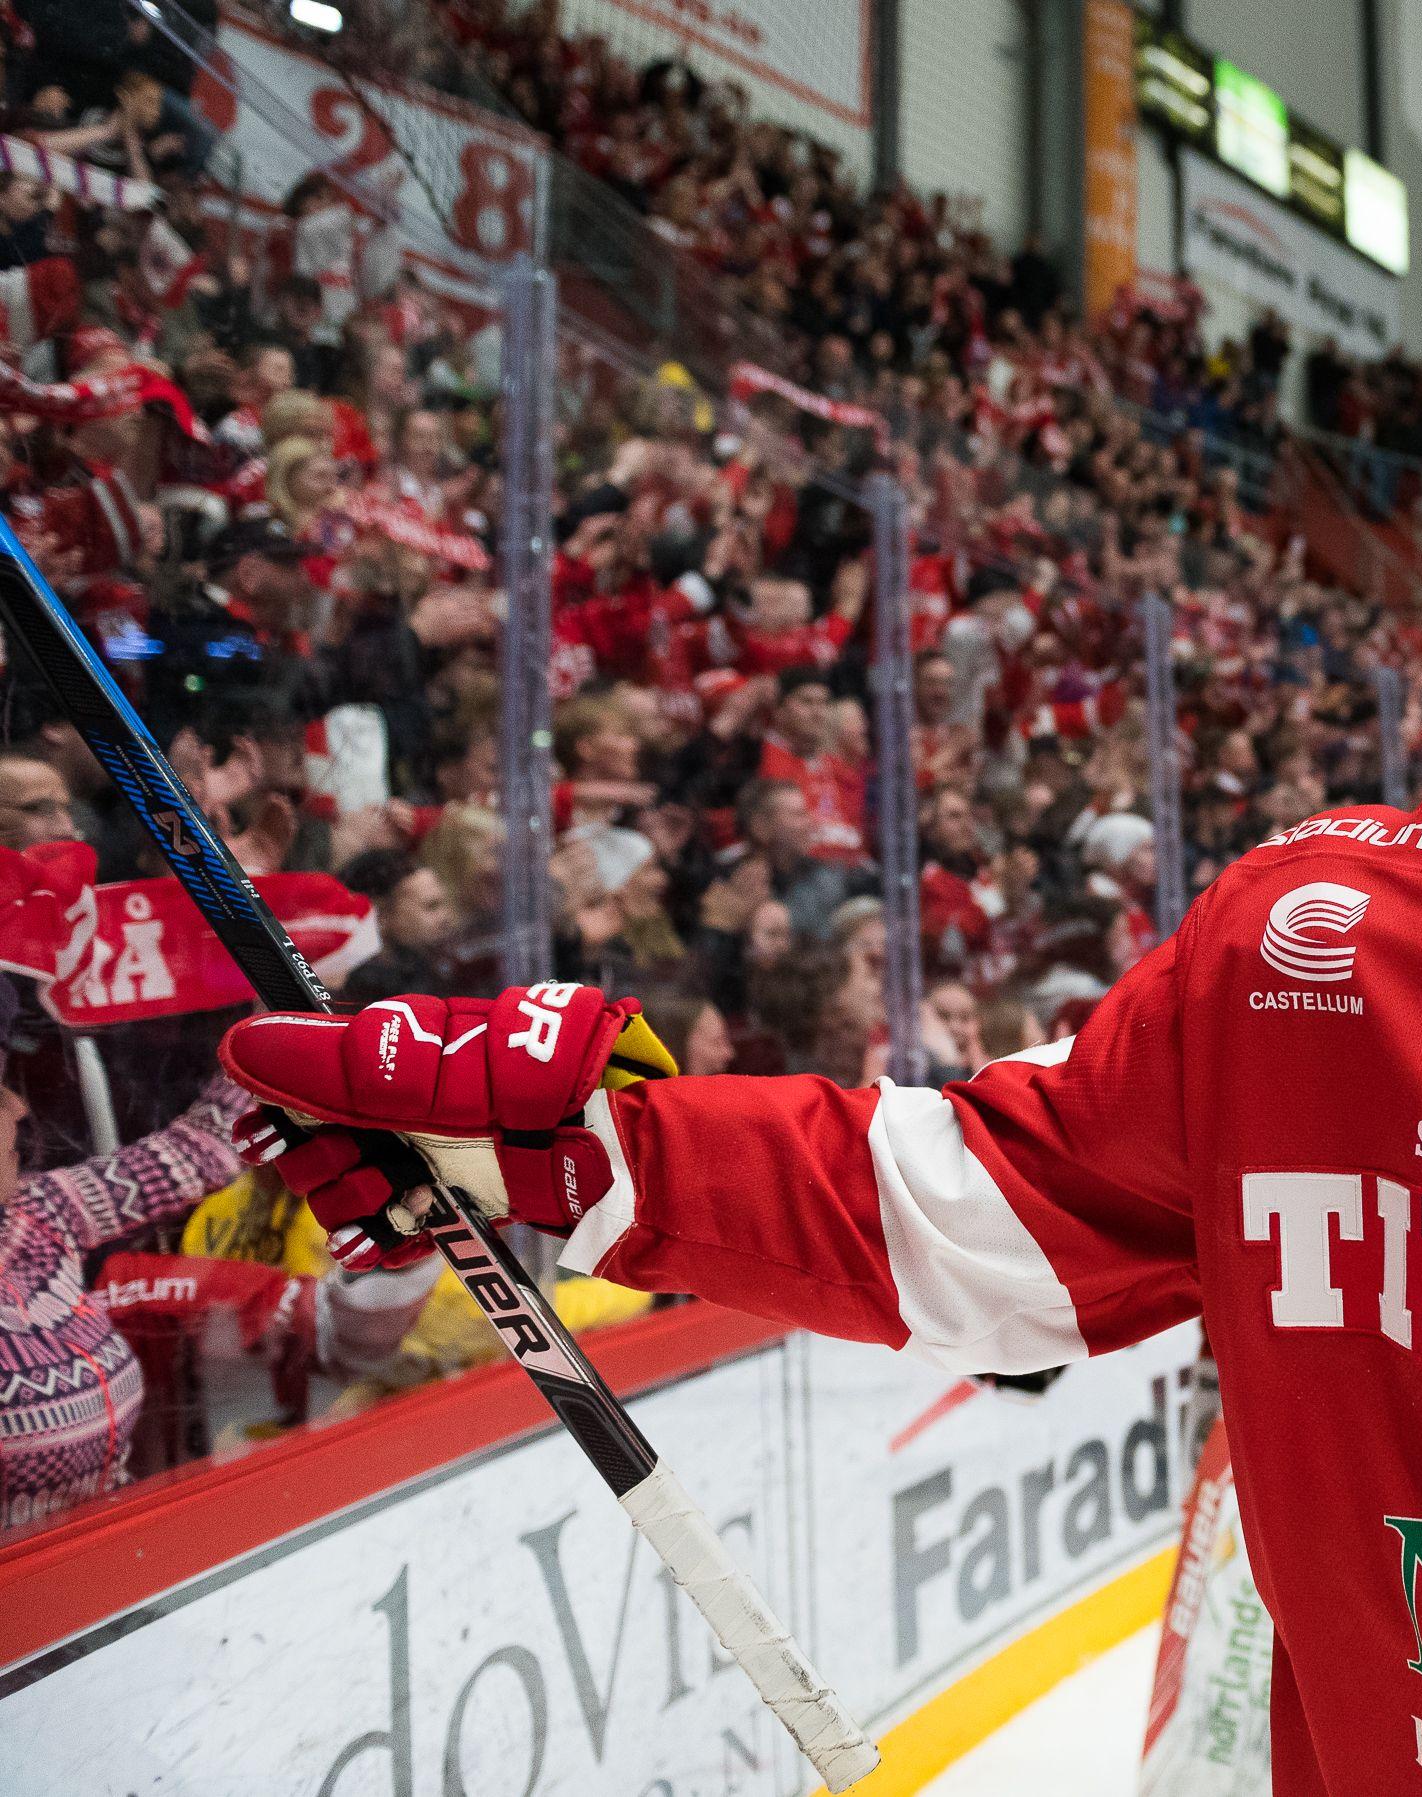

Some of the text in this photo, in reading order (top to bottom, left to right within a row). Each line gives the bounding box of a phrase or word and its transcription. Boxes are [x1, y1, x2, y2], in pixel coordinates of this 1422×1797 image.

[1249, 990, 1364, 1016] CASTELLUM
[563, 1154, 579, 1222] BAUE
[424, 1197, 551, 1359] AUER
